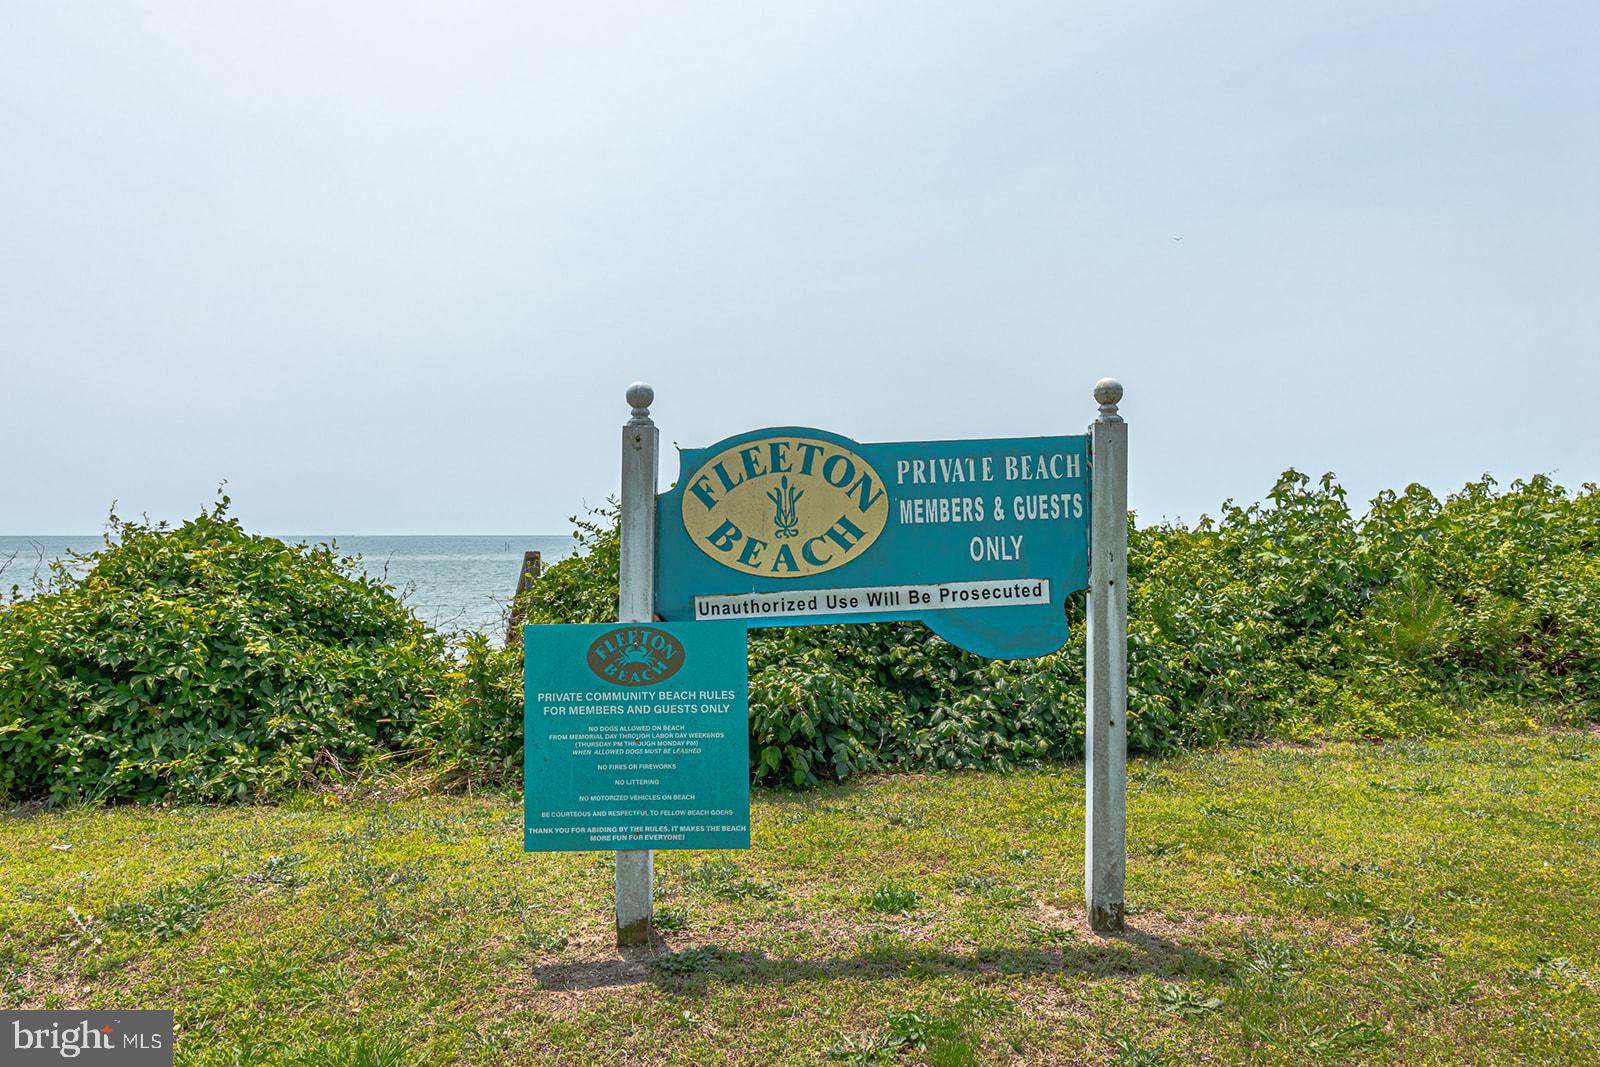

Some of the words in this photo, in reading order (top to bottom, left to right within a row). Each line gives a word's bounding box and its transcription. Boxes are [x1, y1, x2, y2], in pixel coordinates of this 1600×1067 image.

[689, 441, 885, 513] FLEETON
[897, 456, 994, 484] PRIVATE
[1005, 453, 1081, 480] BEACH
[900, 496, 984, 524] MEMBERS
[994, 496, 1005, 521] &
[1013, 493, 1082, 520] GUESTS
[705, 515, 868, 572] BEACH
[970, 535, 1023, 561] ONLY
[699, 596, 817, 616] Unauthorized
[826, 594, 858, 609] Use
[866, 591, 900, 606] Will
[909, 590, 931, 604] Be
[940, 583, 1042, 602] Prosecuted
[595, 630, 678, 661] FLEETON
[604, 663, 668, 683] BEACH
[537, 692, 583, 702] PRIVATE
[585, 691, 656, 701] COMMUNITY
[658, 691, 697, 700] BEACH
[699, 690, 735, 700] RULES
[543, 706, 566, 716] FOR
[568, 705, 625, 715] MEMBERS
[626, 705, 651, 714] AND
[653, 704, 698, 714] GUESTS
[700, 704, 730, 713] ONLY
